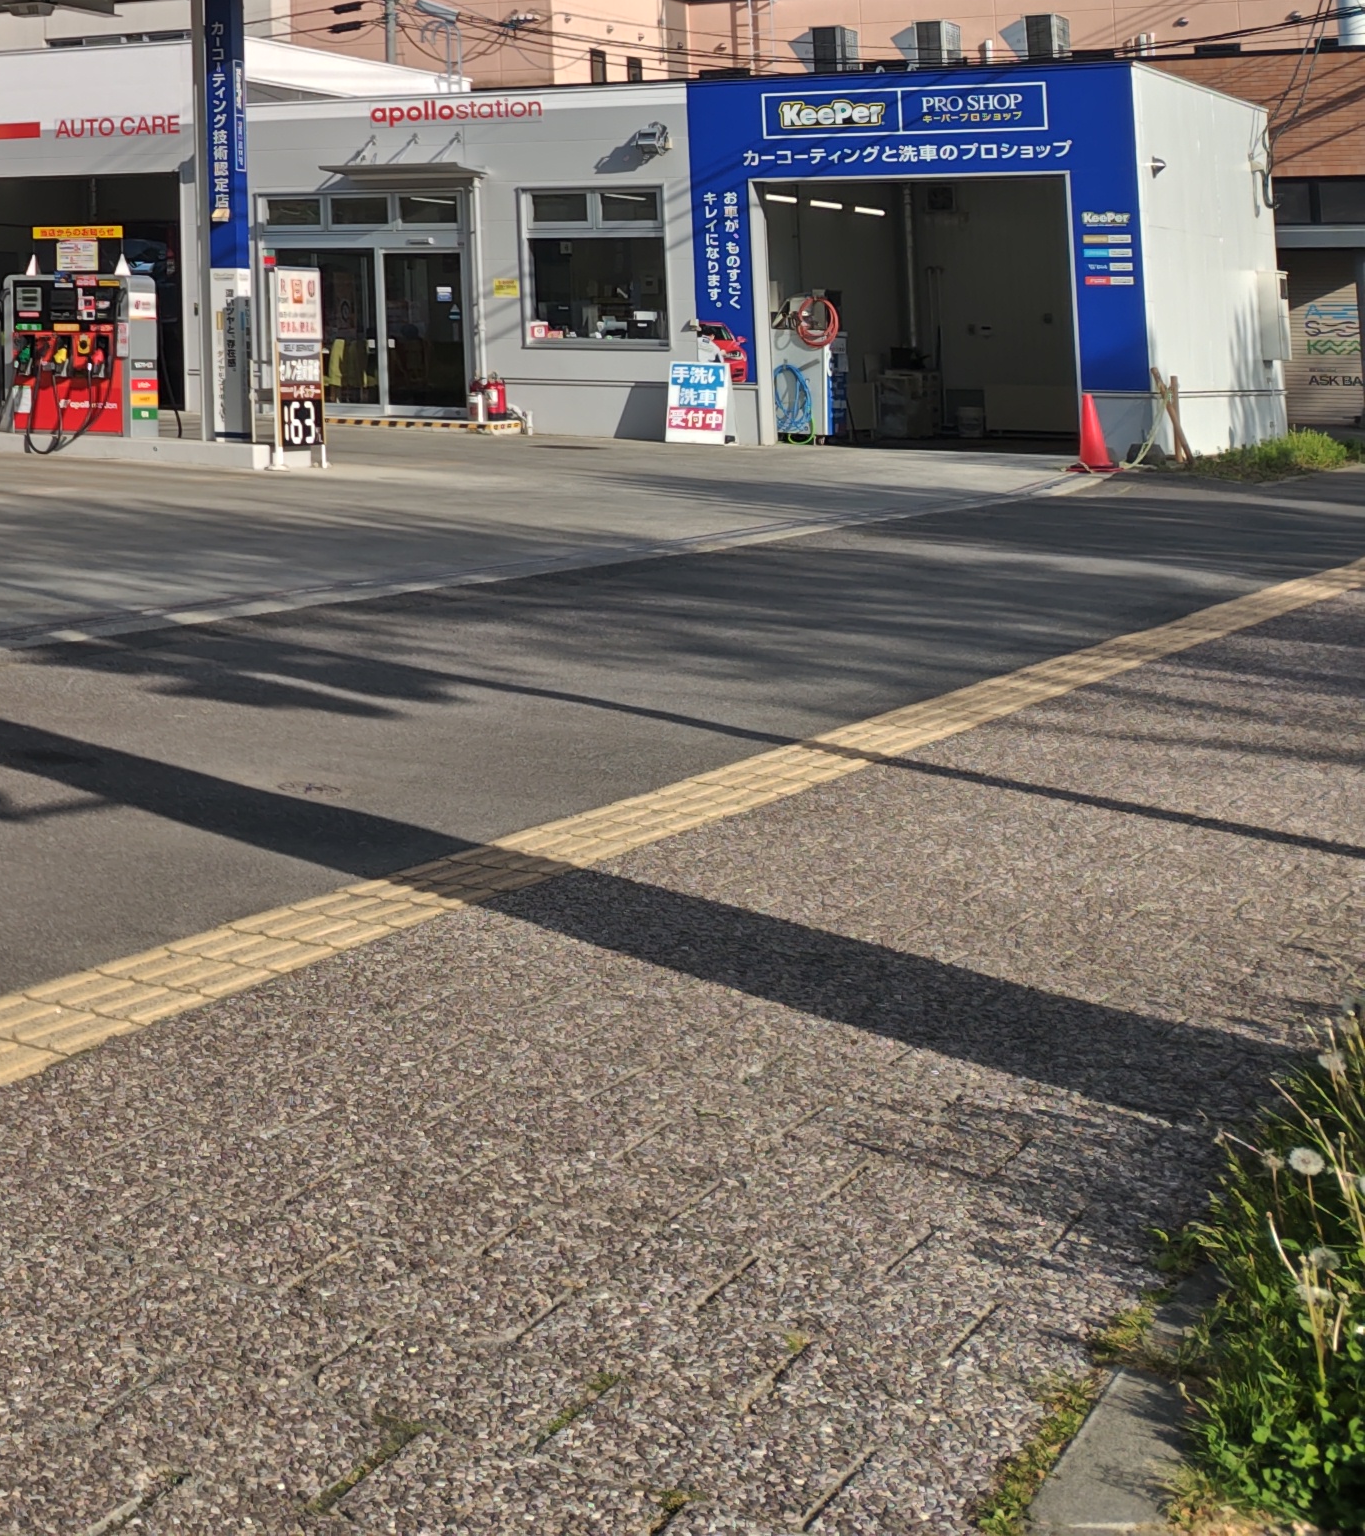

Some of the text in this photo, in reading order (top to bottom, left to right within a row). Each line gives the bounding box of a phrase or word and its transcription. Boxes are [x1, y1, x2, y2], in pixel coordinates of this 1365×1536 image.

[371, 98, 543, 127] apollostation
[779, 98, 885, 129] KeePer
[921, 93, 1023, 113] PRO SHOP
[211, 21, 229, 208] カーコーティング技術認定店
[922, 111, 1022, 124] キーパープロショップ
[55, 115, 180, 138] AUTO CARE
[743, 140, 1072, 166] カーコーティングと洗車のプロショップ
[1082, 211, 1130, 224] KeePer
[40, 228, 115, 237] 当店からのお知らせ
[703, 192, 722, 308] キレイになります。
[724, 191, 741, 309] お車が、ものすごく
[672, 366, 725, 384] 手洗い
[1309, 375, 1340, 386] ASK
[680, 388, 717, 406] 洗車
[283, 400, 316, 444] 163
[669, 409, 723, 429] 受付中
